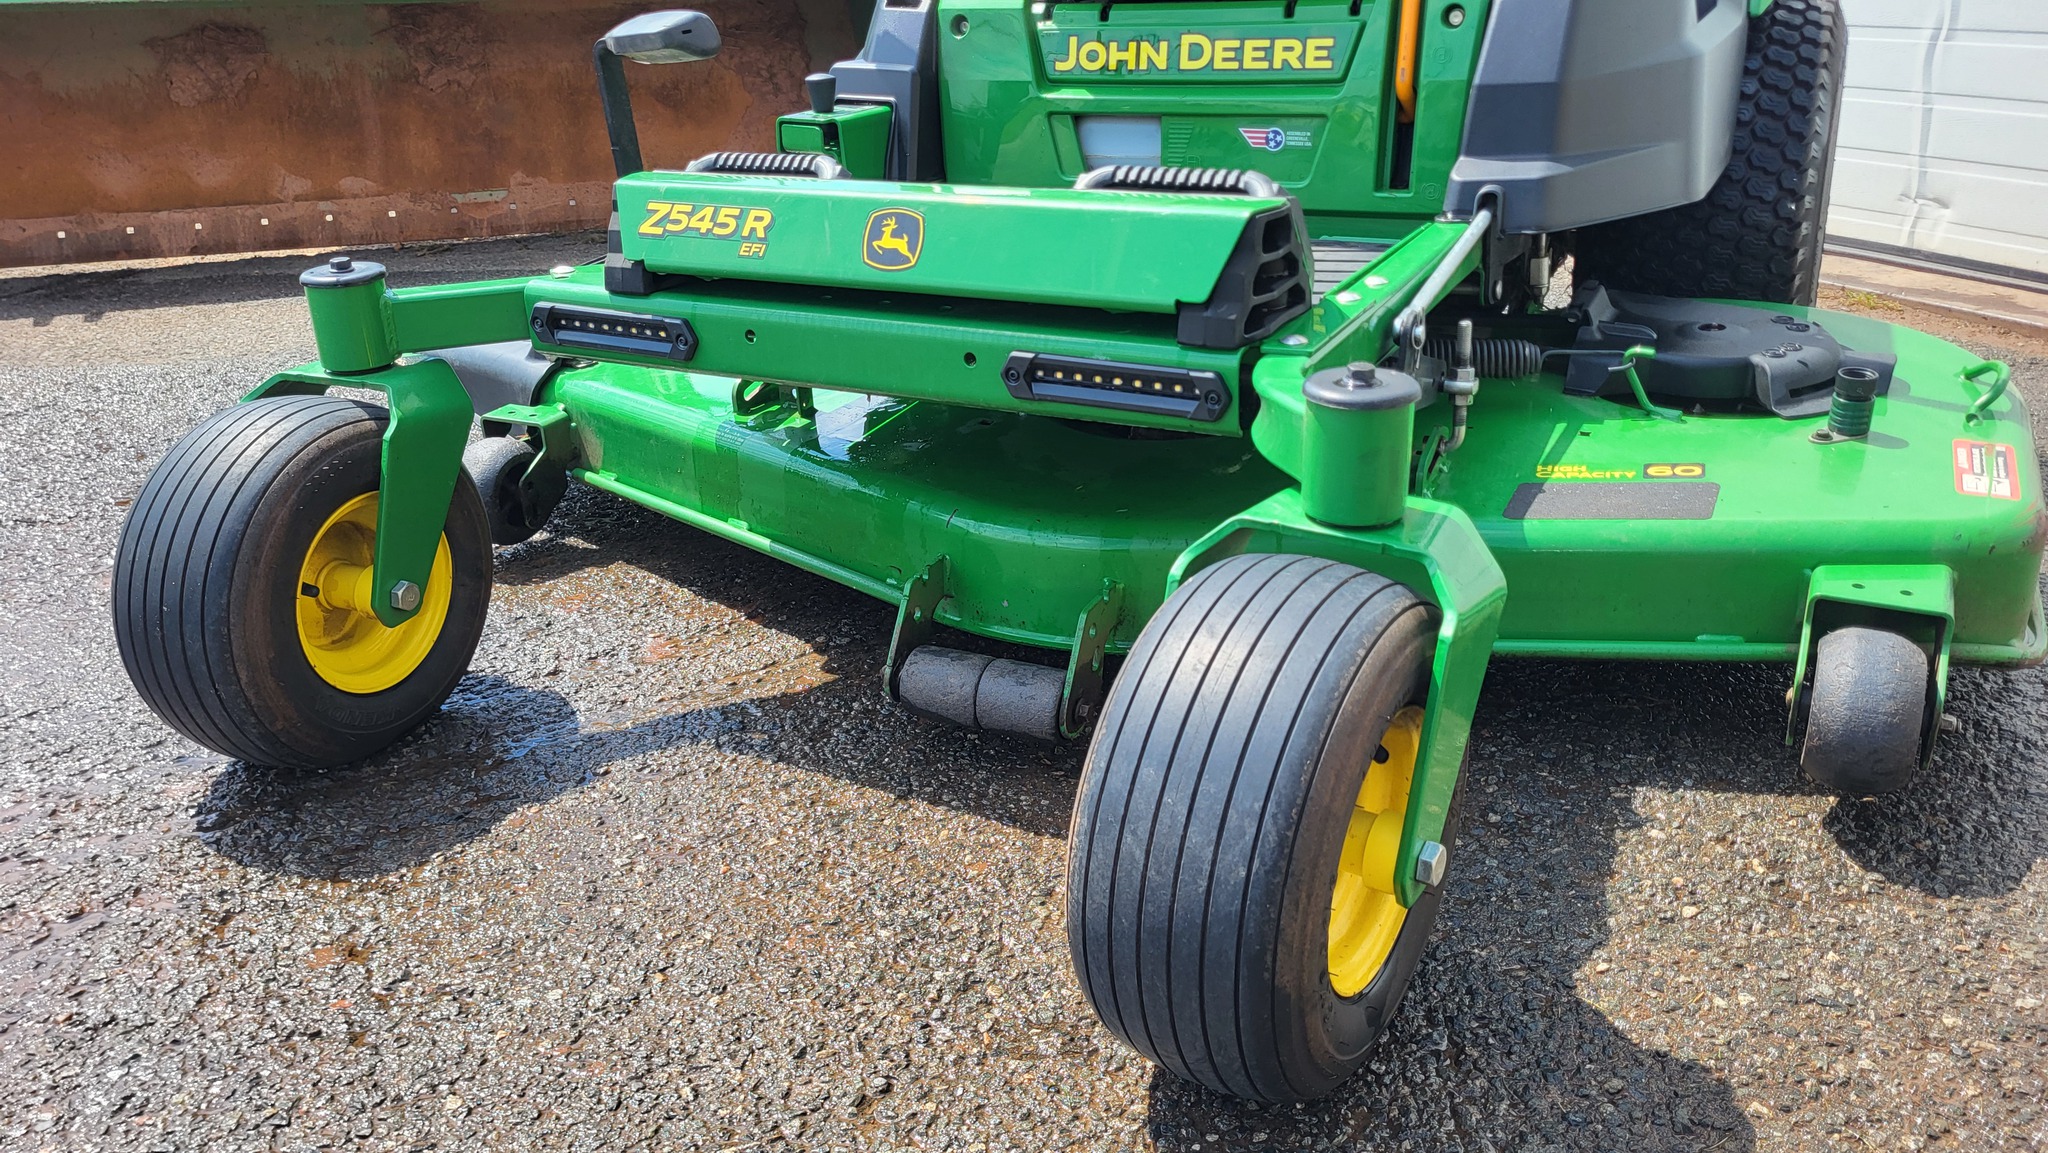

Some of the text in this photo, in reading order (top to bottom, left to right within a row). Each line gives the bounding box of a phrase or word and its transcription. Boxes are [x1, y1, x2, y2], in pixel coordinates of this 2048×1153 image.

[1054, 33, 1336, 71] JOHN DEERE
[637, 202, 742, 236] Z545
[738, 242, 767, 257] EFI
[1535, 471, 1637, 479] CAPACITY
[1646, 465, 1703, 477] 60
